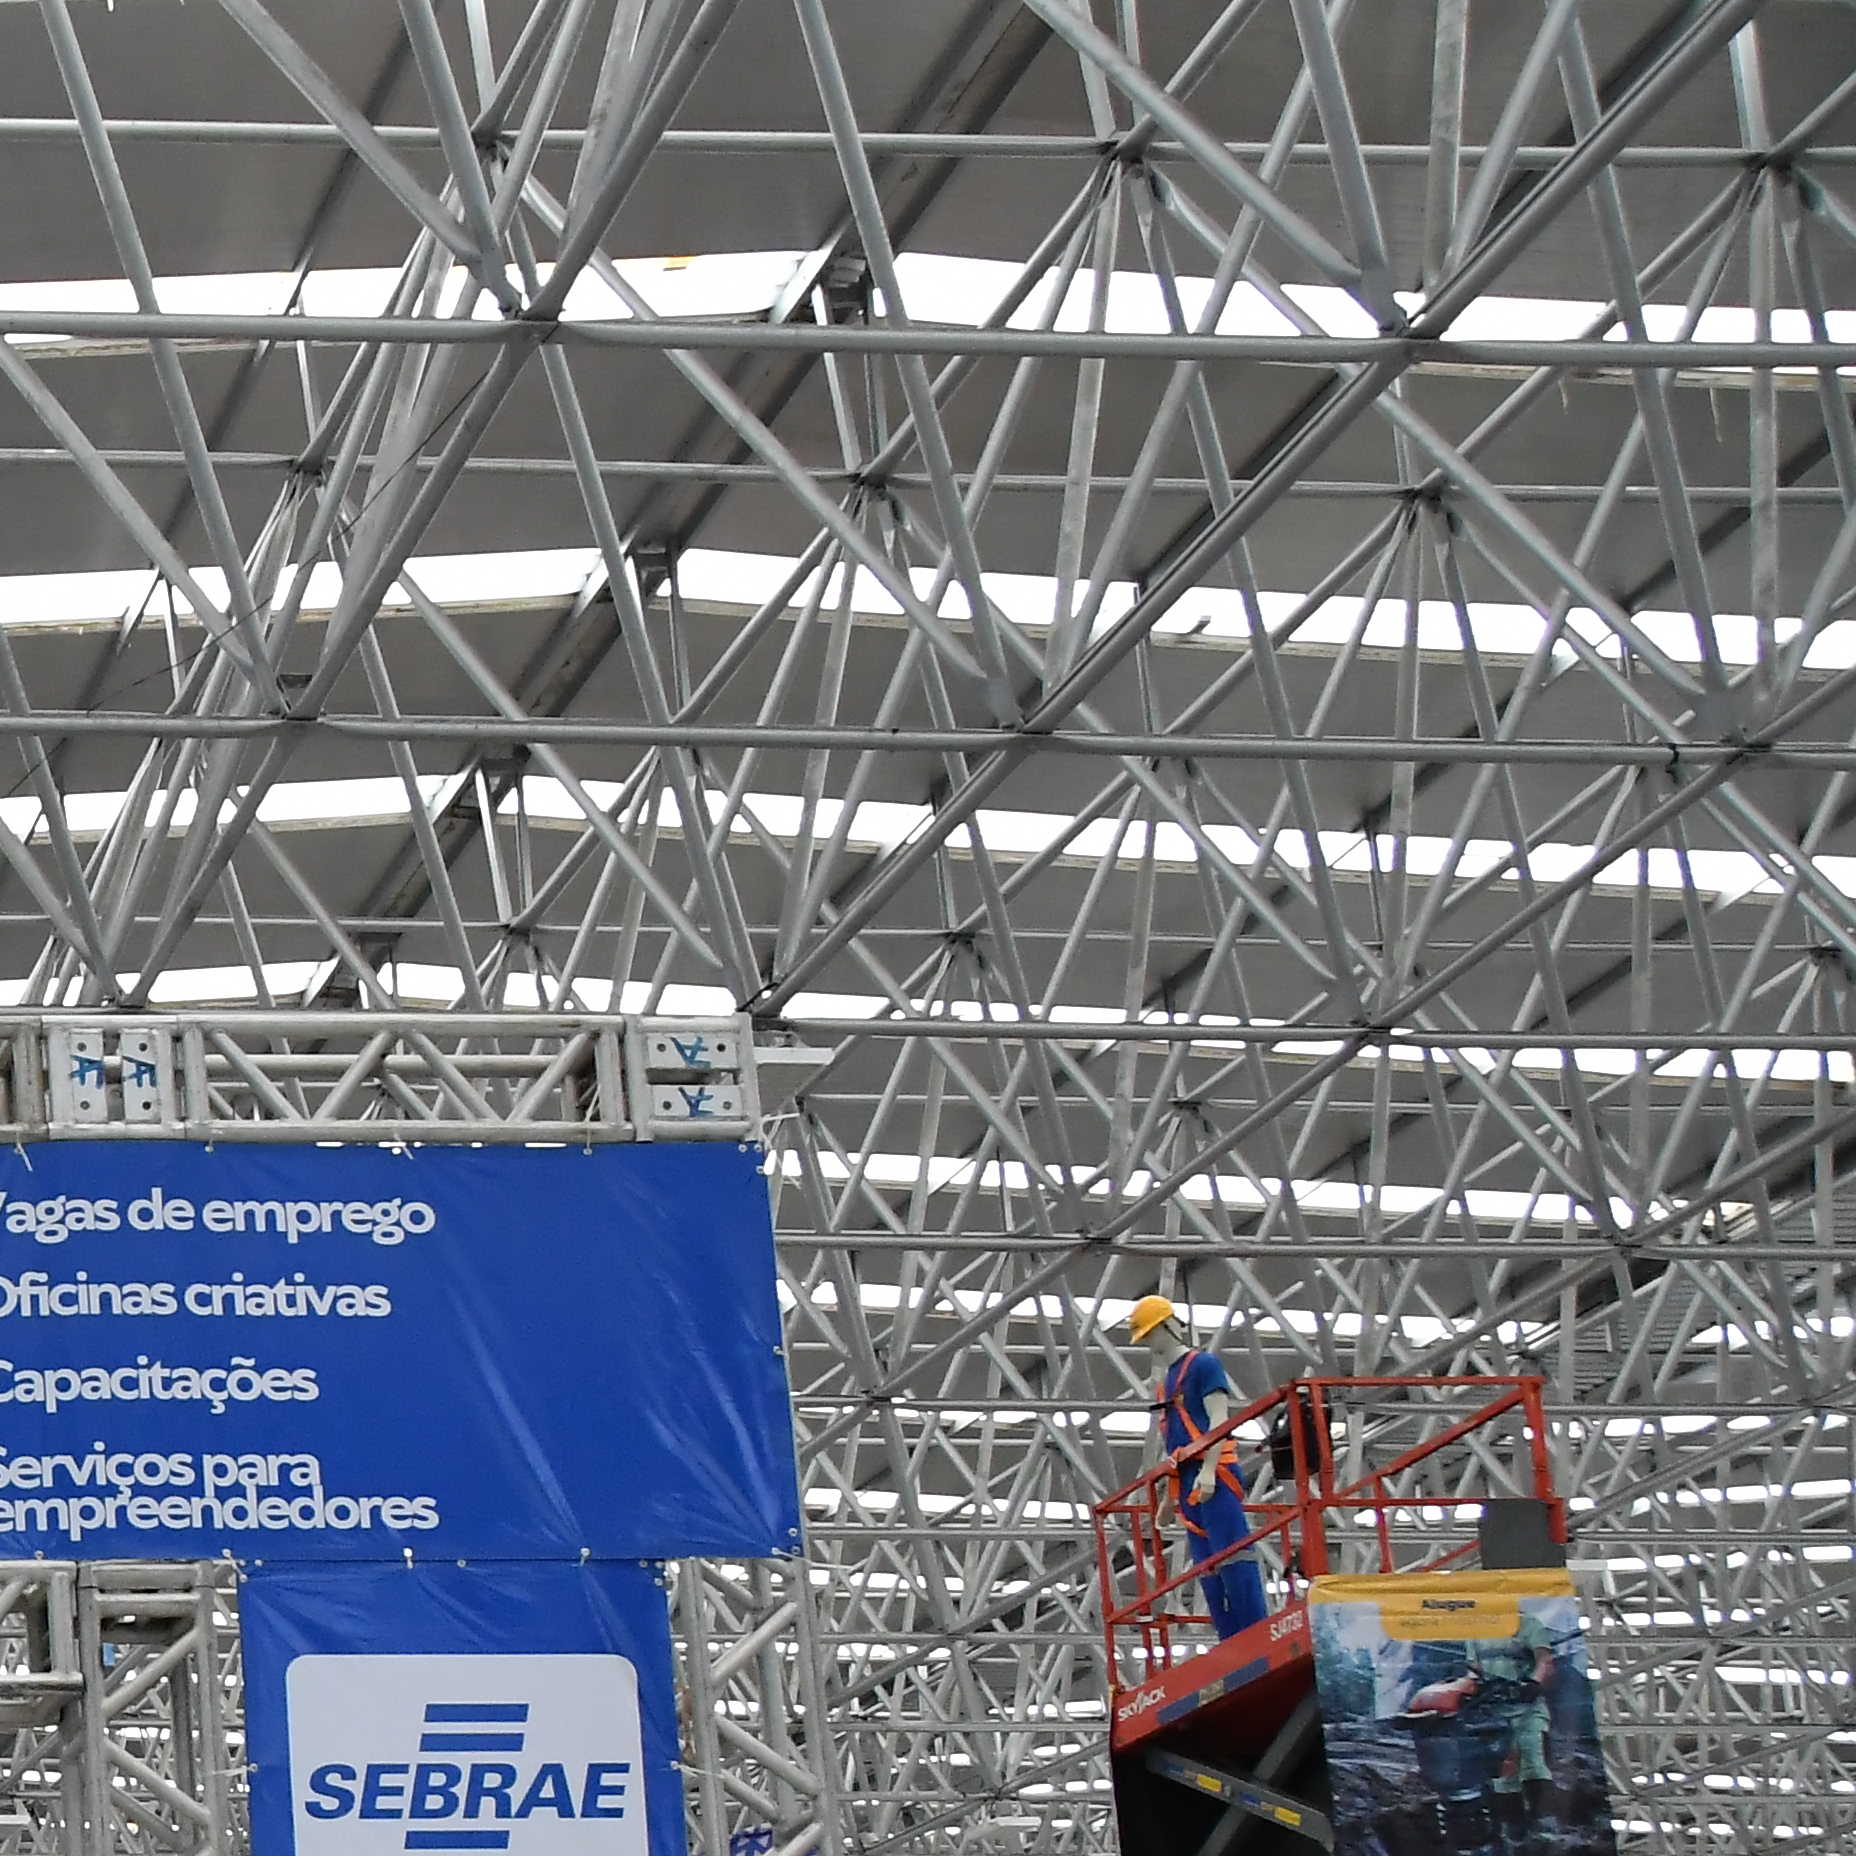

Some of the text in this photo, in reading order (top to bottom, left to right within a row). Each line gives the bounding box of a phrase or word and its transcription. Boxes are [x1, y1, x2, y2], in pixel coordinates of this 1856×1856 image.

[129, 1187, 195, 1232] de
[202, 1196, 435, 1245] emprego
[184, 1271, 391, 1318] criativas
[202, 1450, 319, 1494] para
[305, 1761, 632, 1821] SEBRAE
